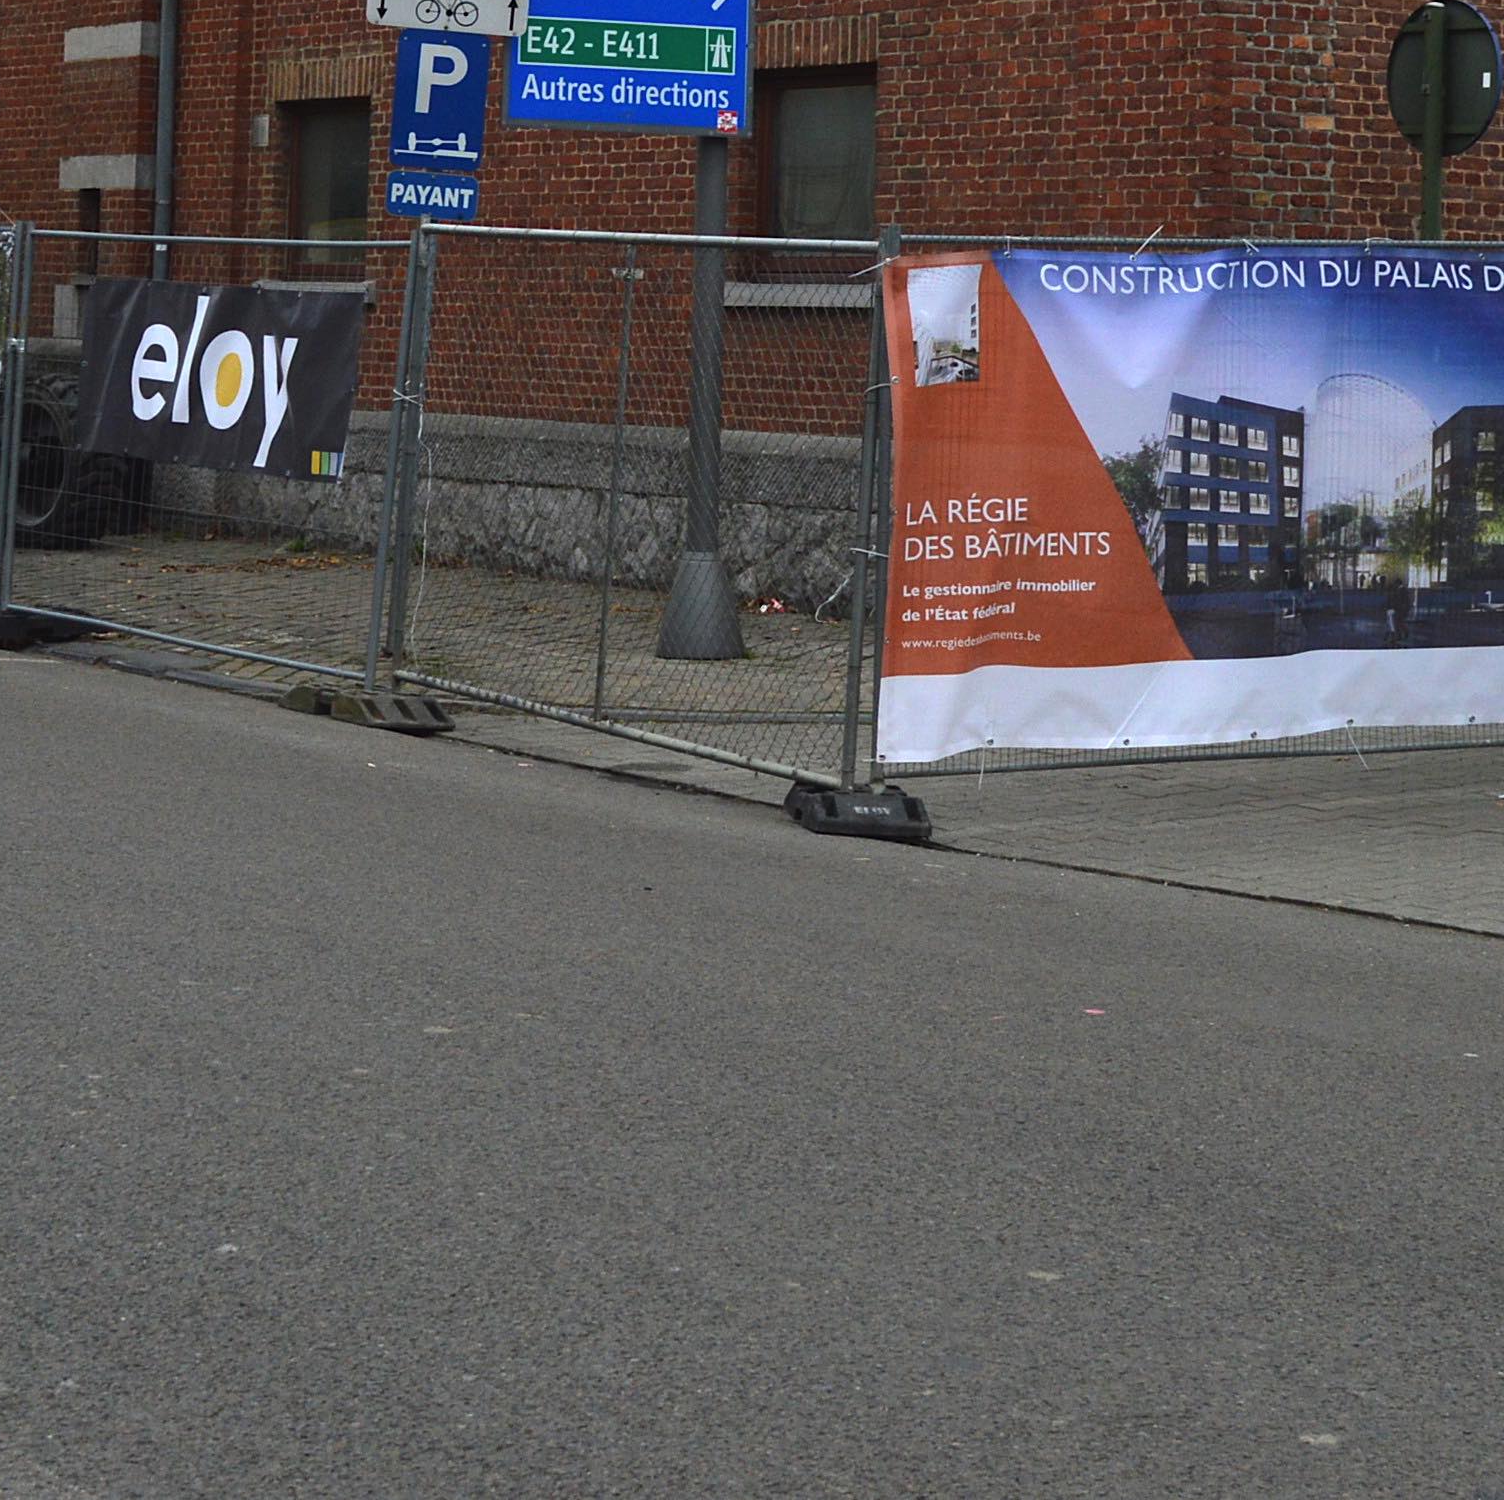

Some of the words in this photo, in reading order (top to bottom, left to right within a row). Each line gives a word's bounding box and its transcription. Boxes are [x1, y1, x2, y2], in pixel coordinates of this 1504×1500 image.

[527, 26, 575, 56] E42
[603, 30, 659, 60] E411
[415, 43, 468, 113] P
[522, 74, 604, 104] Autres
[612, 78, 729, 108] directions
[391, 182, 474, 210] PAYANT
[1040, 261, 1304, 294] CONSTRUCTION
[1320, 261, 1362, 288] DU
[1374, 261, 1474, 290] PALAIS
[132, 296, 298, 469] eloy
[906, 502, 938, 526] LA
[948, 493, 1028, 523] RÉGIE
[904, 536, 954, 561] DES
[965, 529, 1110, 558] BÂTIMENTS
[903, 585, 920, 597] Le
[924, 581, 1011, 599] gestionnaire
[1016, 579, 1096, 593] immobilier
[902, 609, 920, 622] de
[925, 606, 968, 621] l'État
[973, 602, 1016, 619] fédéral
